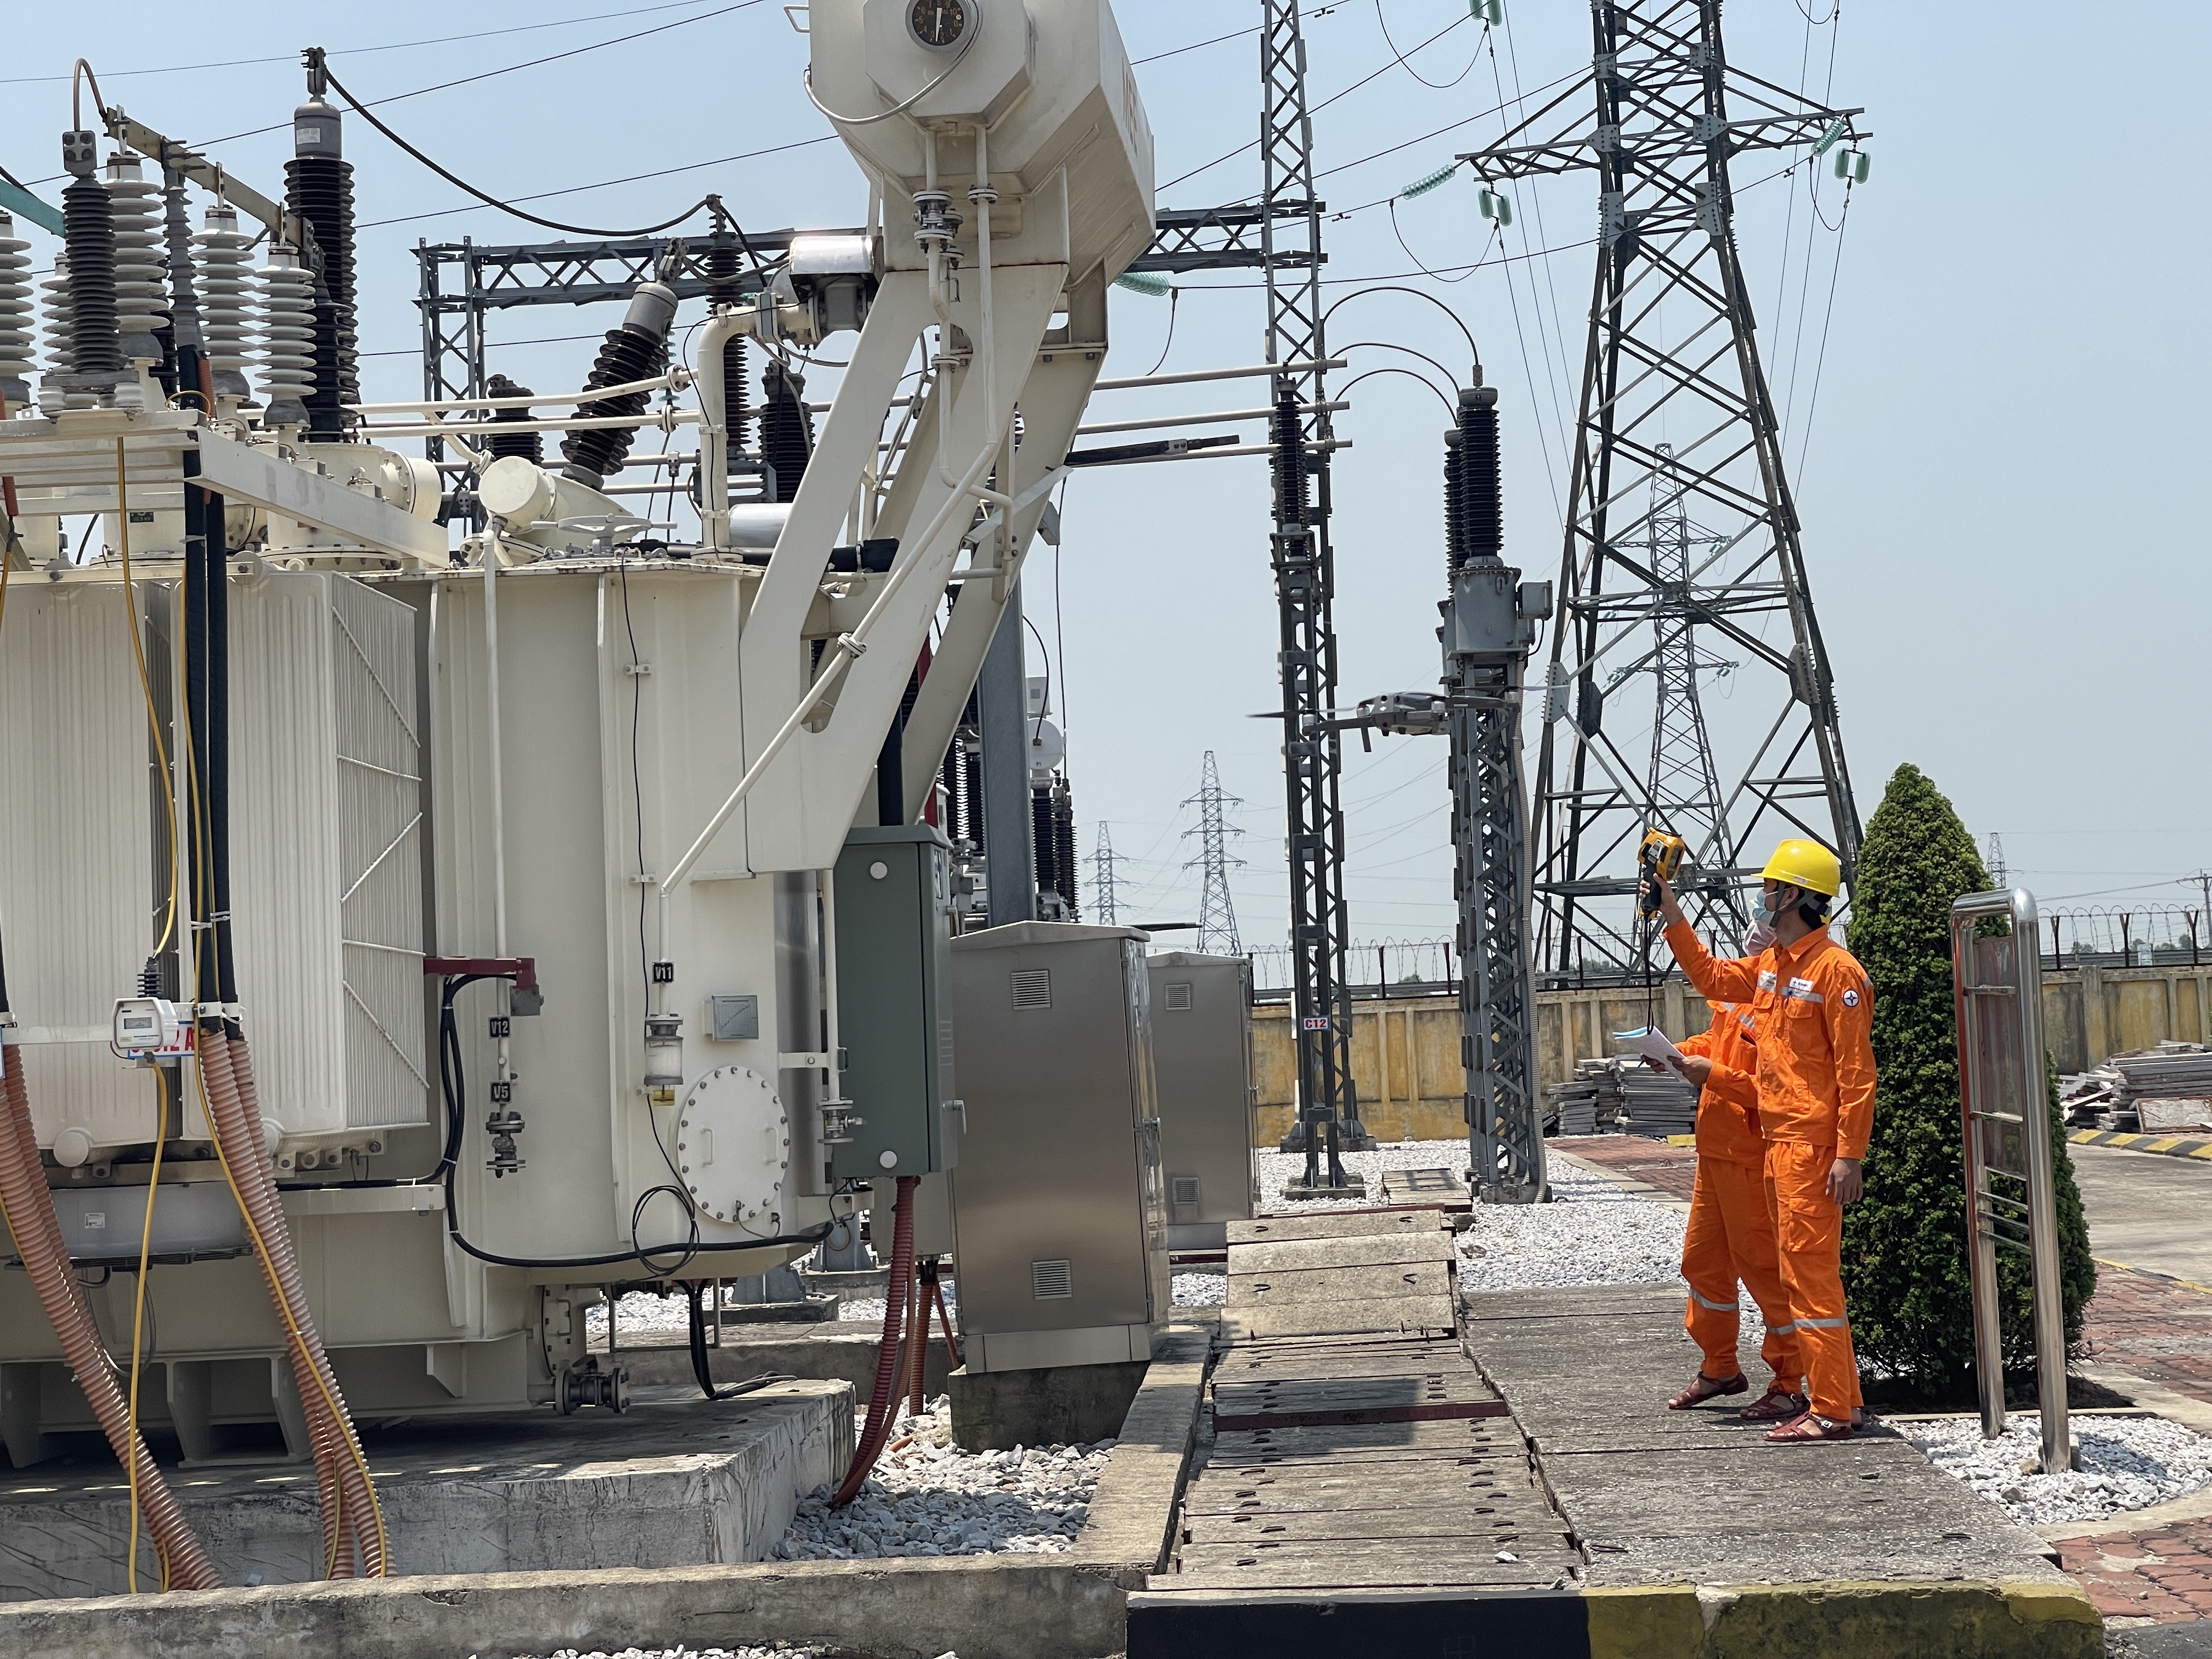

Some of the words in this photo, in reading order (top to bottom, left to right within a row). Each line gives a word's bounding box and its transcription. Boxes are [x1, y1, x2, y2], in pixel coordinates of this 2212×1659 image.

[655, 966, 672, 979] V11
[490, 1020, 509, 1034] V12
[1305, 1019, 1327, 1029] C12
[494, 1086, 509, 1099] V5
